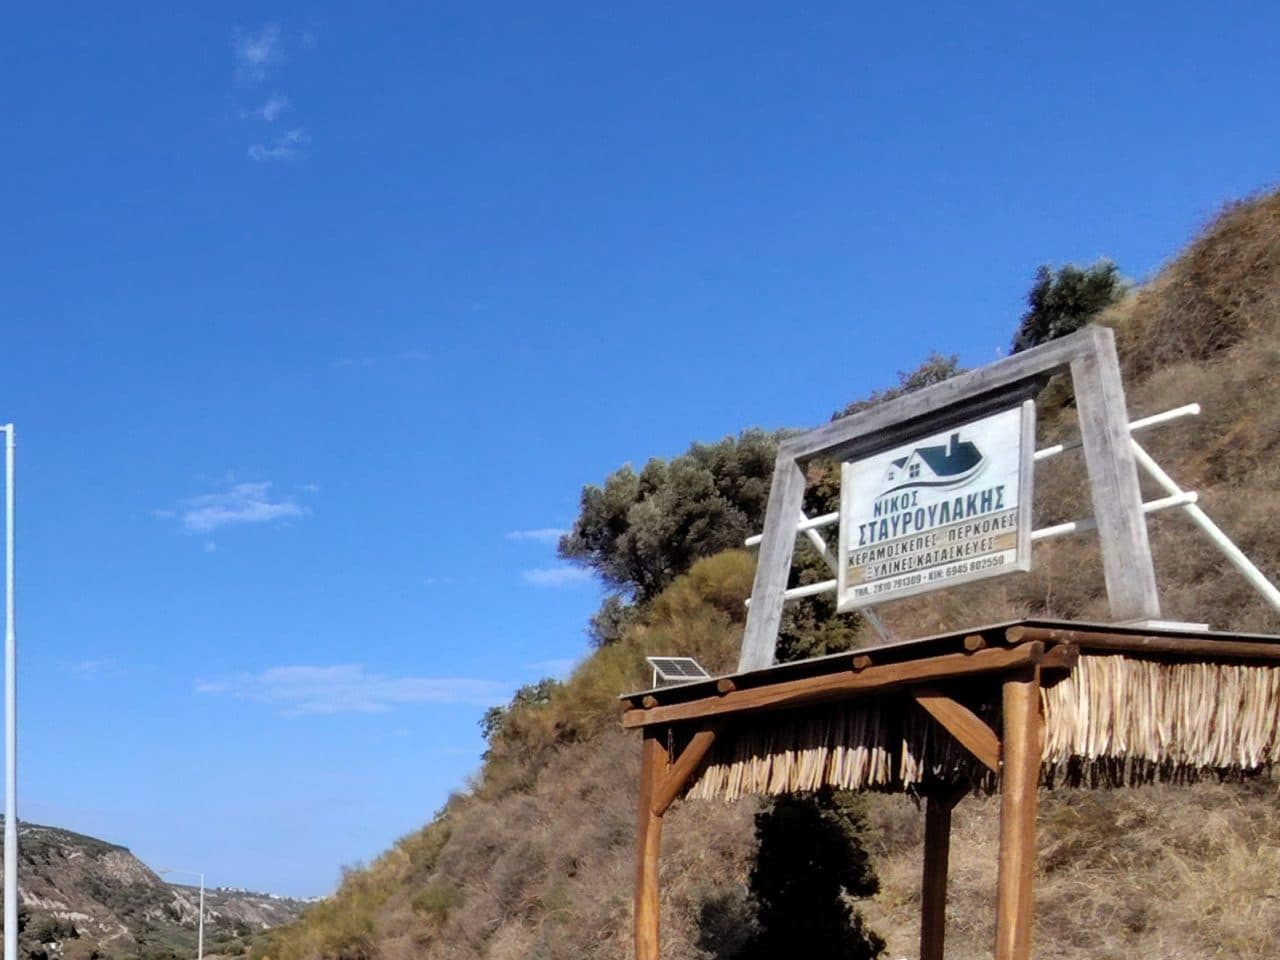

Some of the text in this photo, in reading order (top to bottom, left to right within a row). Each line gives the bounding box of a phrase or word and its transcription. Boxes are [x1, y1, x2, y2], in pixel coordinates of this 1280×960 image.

[858, 485, 1005, 546] ΣΤΑΥΡΟΥΛΑΚΗΣ
[874, 490, 918, 518] ΝΙΚΟΣ
[848, 513, 1015, 567] ΚΕΡΑΜΟΣΚΕΠΕΣ ΠΕΡΚΟΛΕΣ
[867, 536, 994, 579] ΞΥΛΙΝΕΣ ΚΑΤΑΣΚΕΥΕΣ
